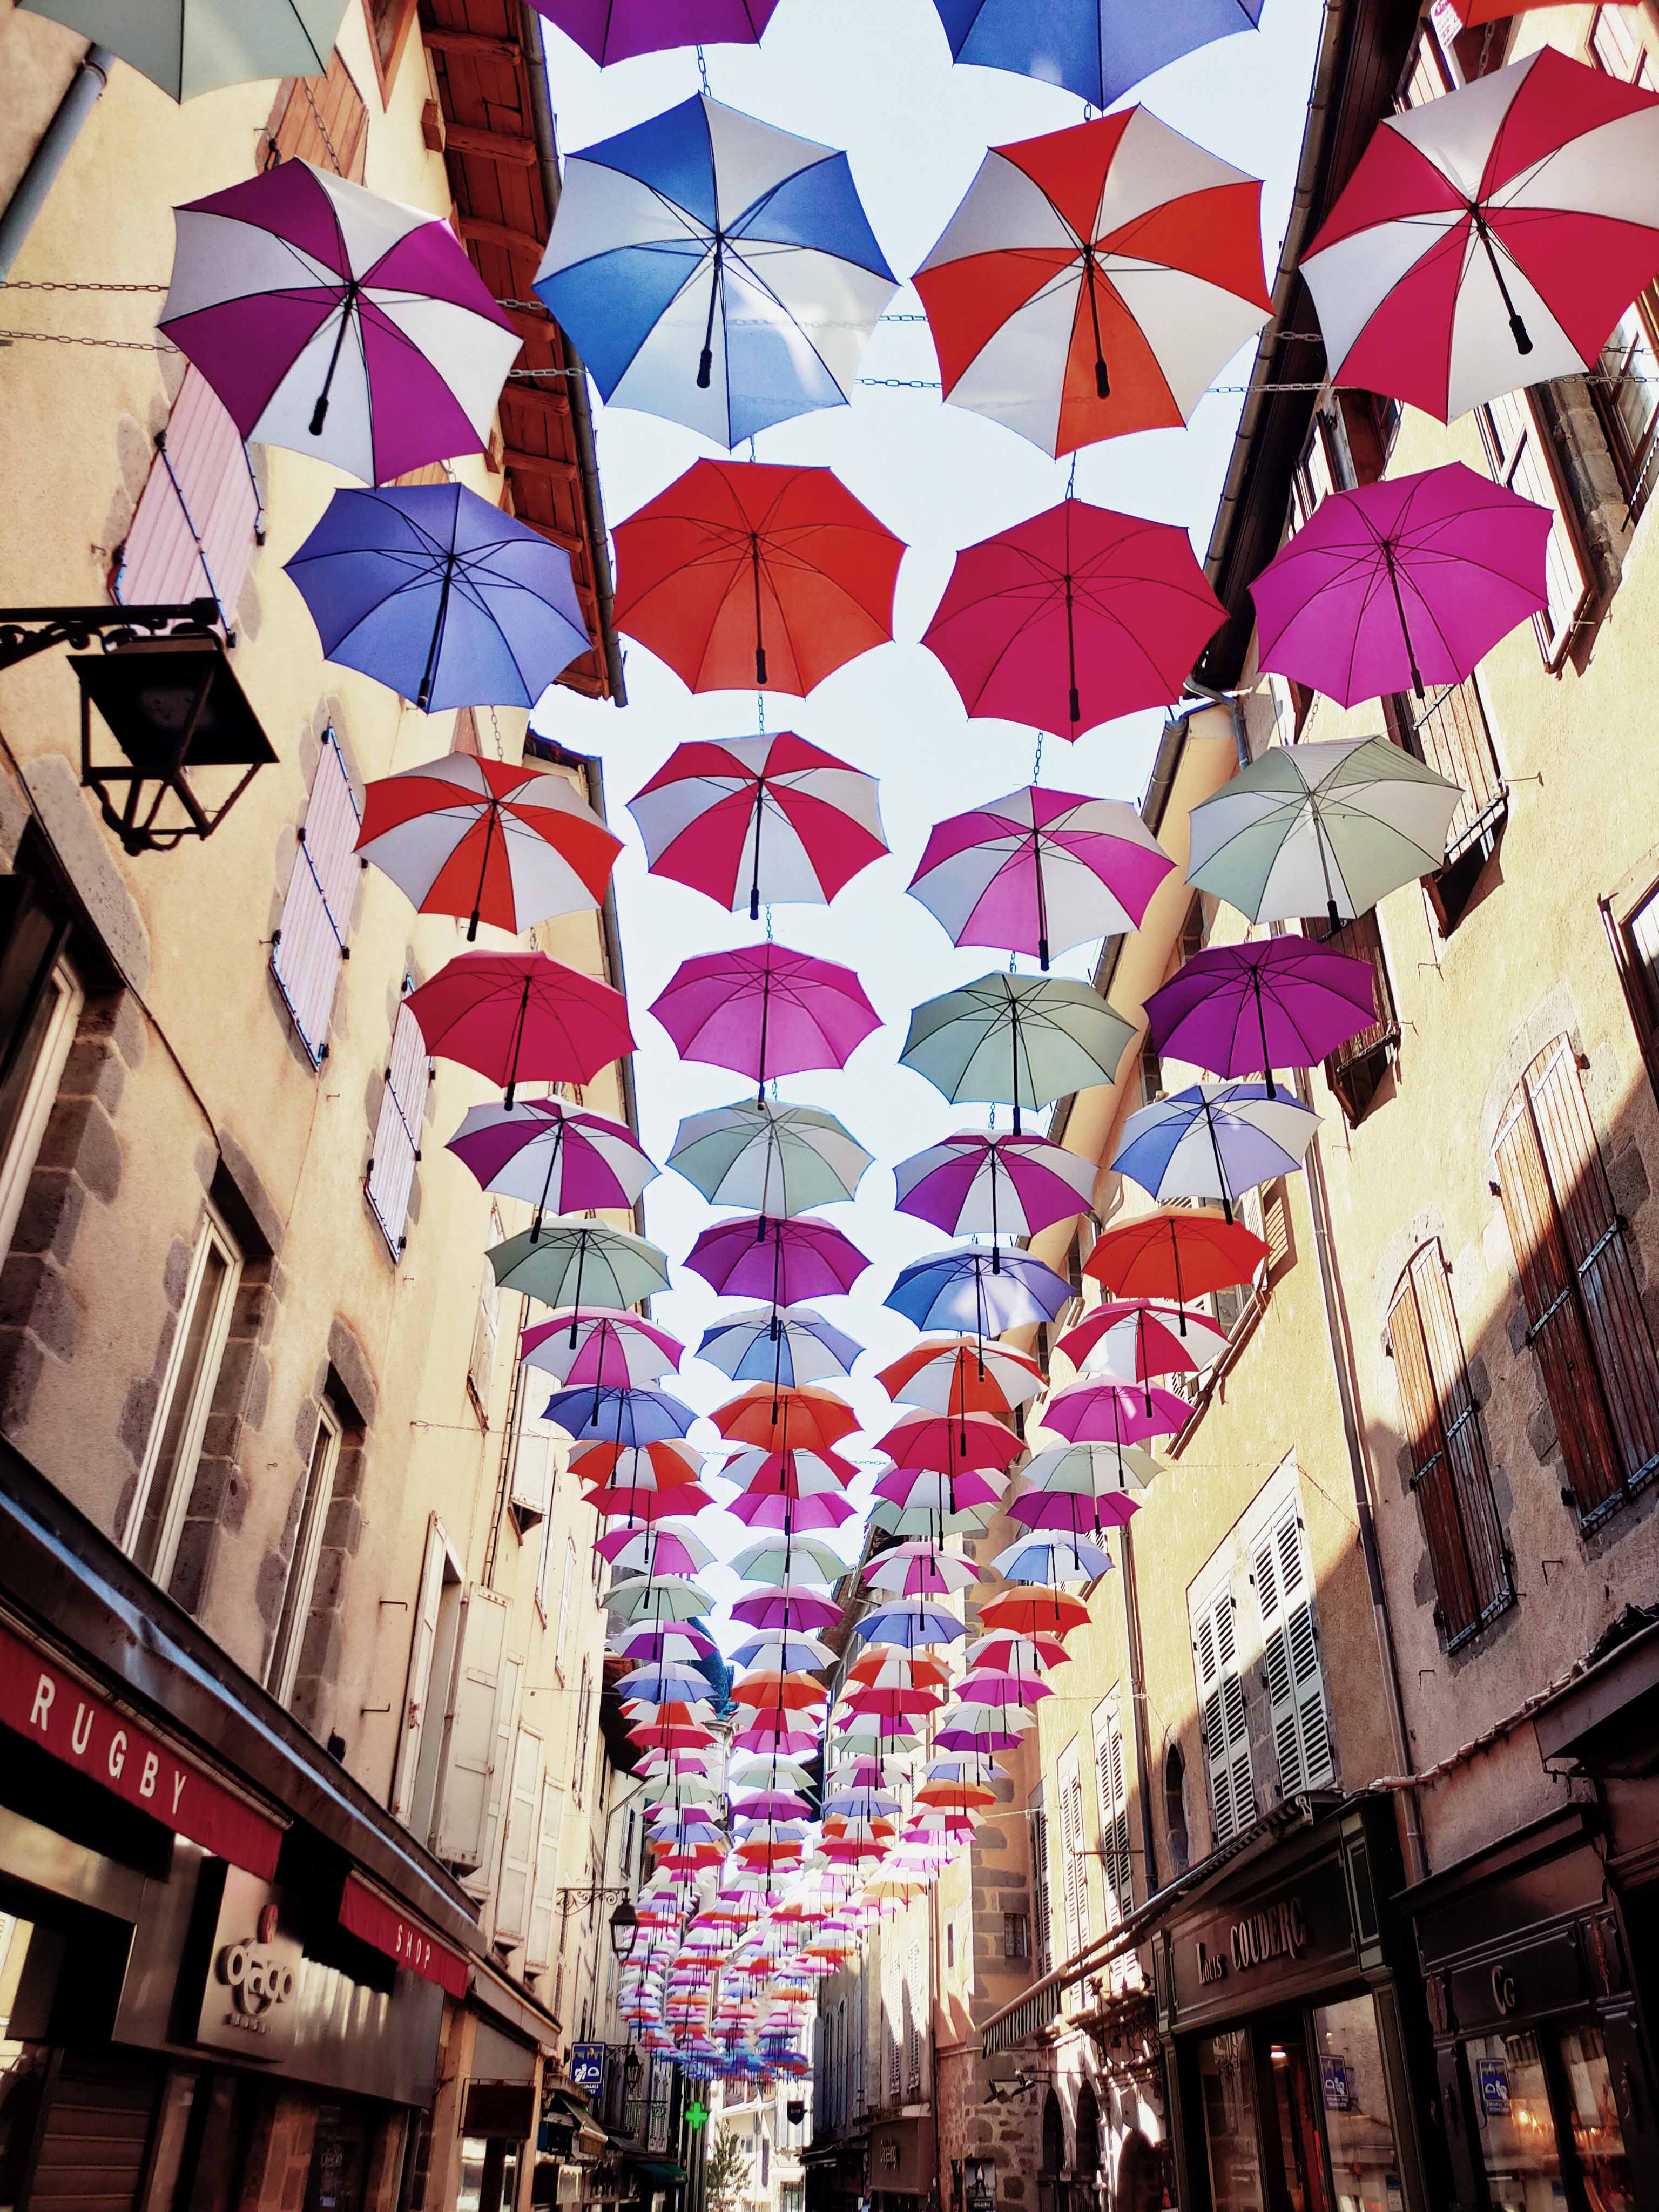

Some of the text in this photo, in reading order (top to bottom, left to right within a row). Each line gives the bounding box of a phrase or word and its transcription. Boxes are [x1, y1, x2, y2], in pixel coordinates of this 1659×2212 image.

[30, 1673, 187, 1815] RUGBY
[396, 1924, 431, 1970] SHOP
[1230, 1897, 1305, 1971] COUDERC
